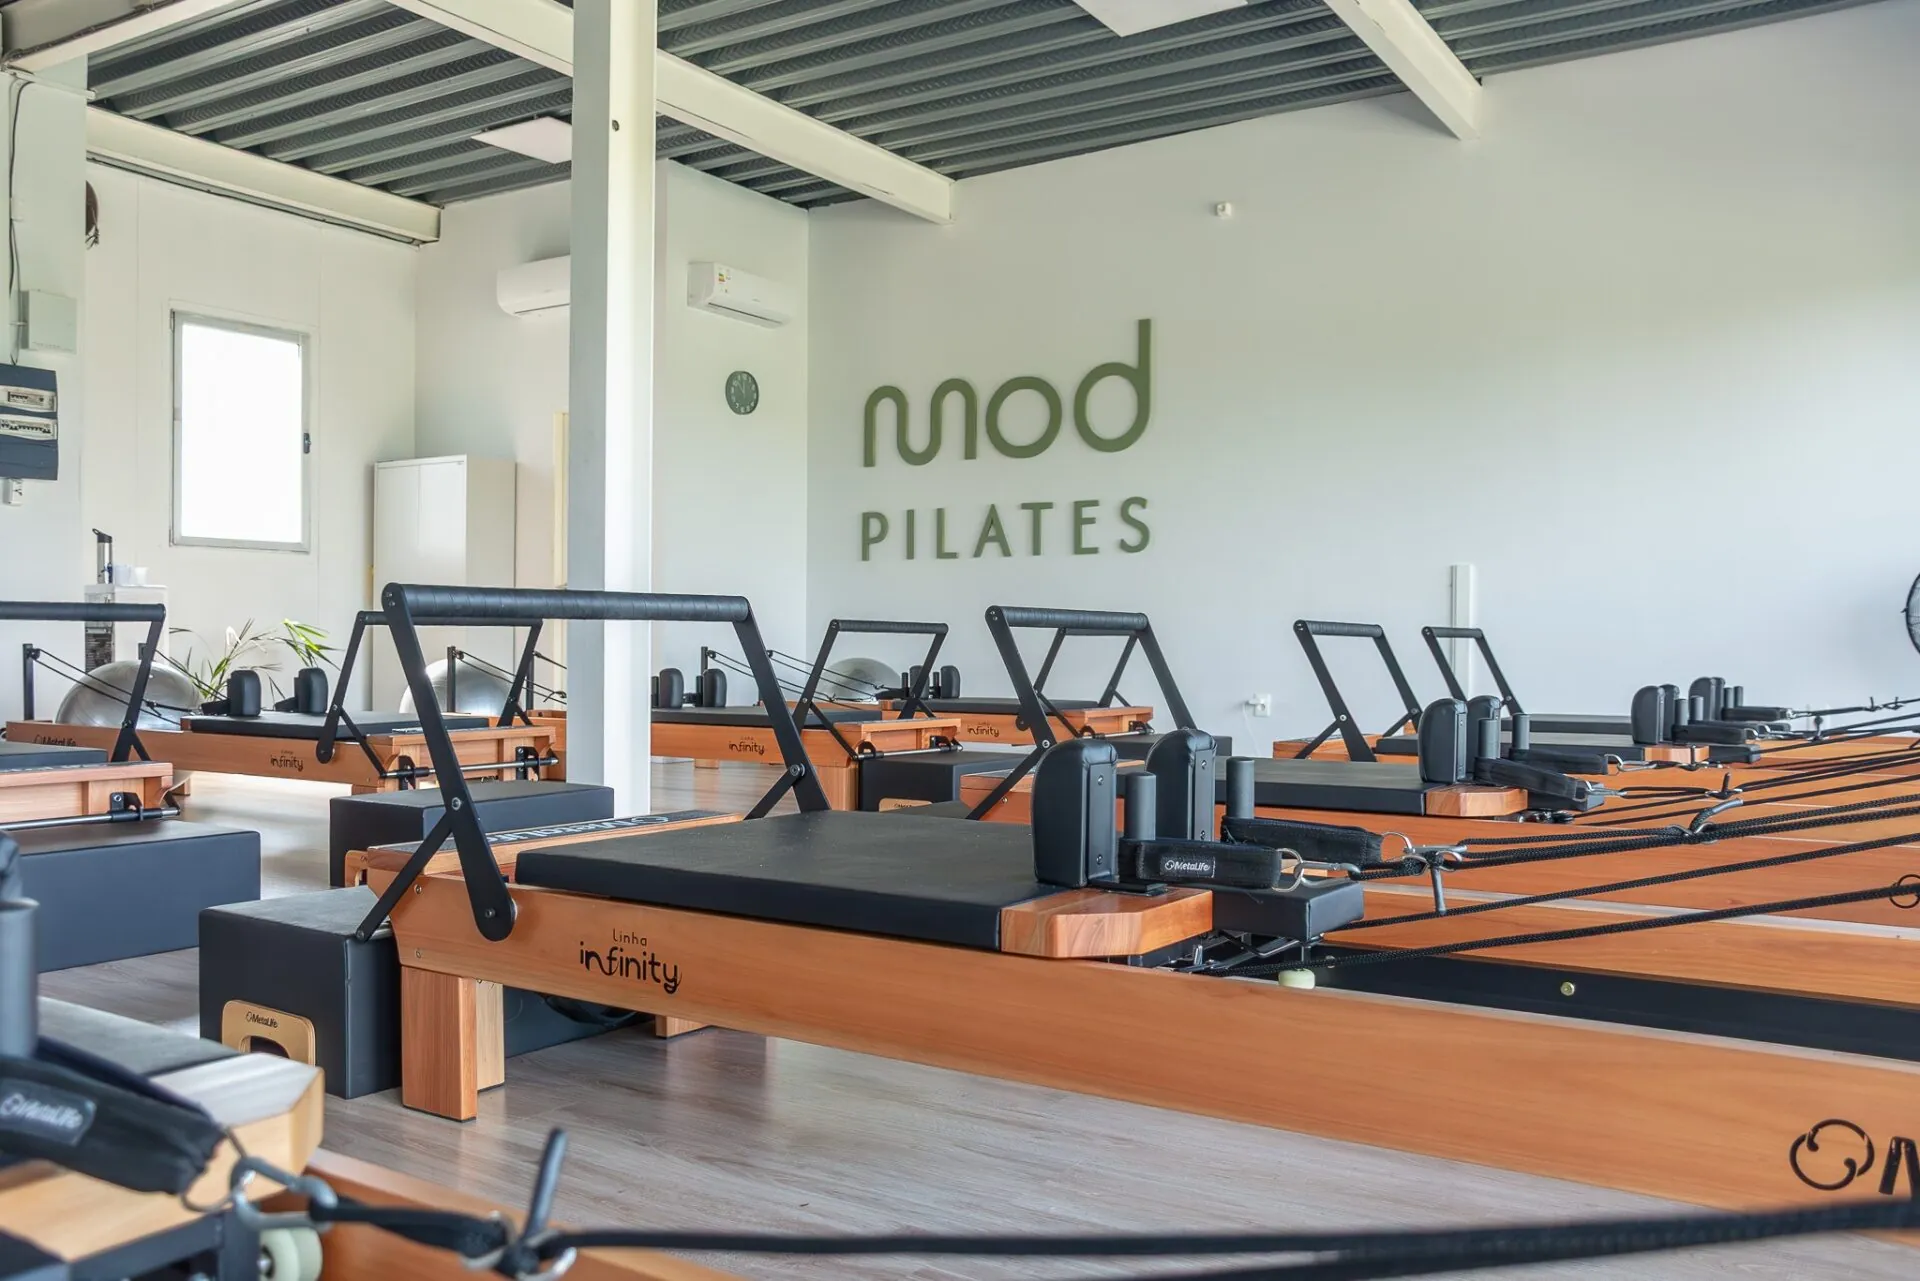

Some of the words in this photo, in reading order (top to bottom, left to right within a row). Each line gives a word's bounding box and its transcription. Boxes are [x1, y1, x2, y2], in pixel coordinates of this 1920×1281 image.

[862, 318, 1152, 467] mod
[861, 496, 1150, 561] PILATES
[270, 754, 304, 772] infinity
[728, 740, 765, 756] infinity
[1174, 861, 1211, 871] MetaLife
[579, 940, 683, 994] infinity
